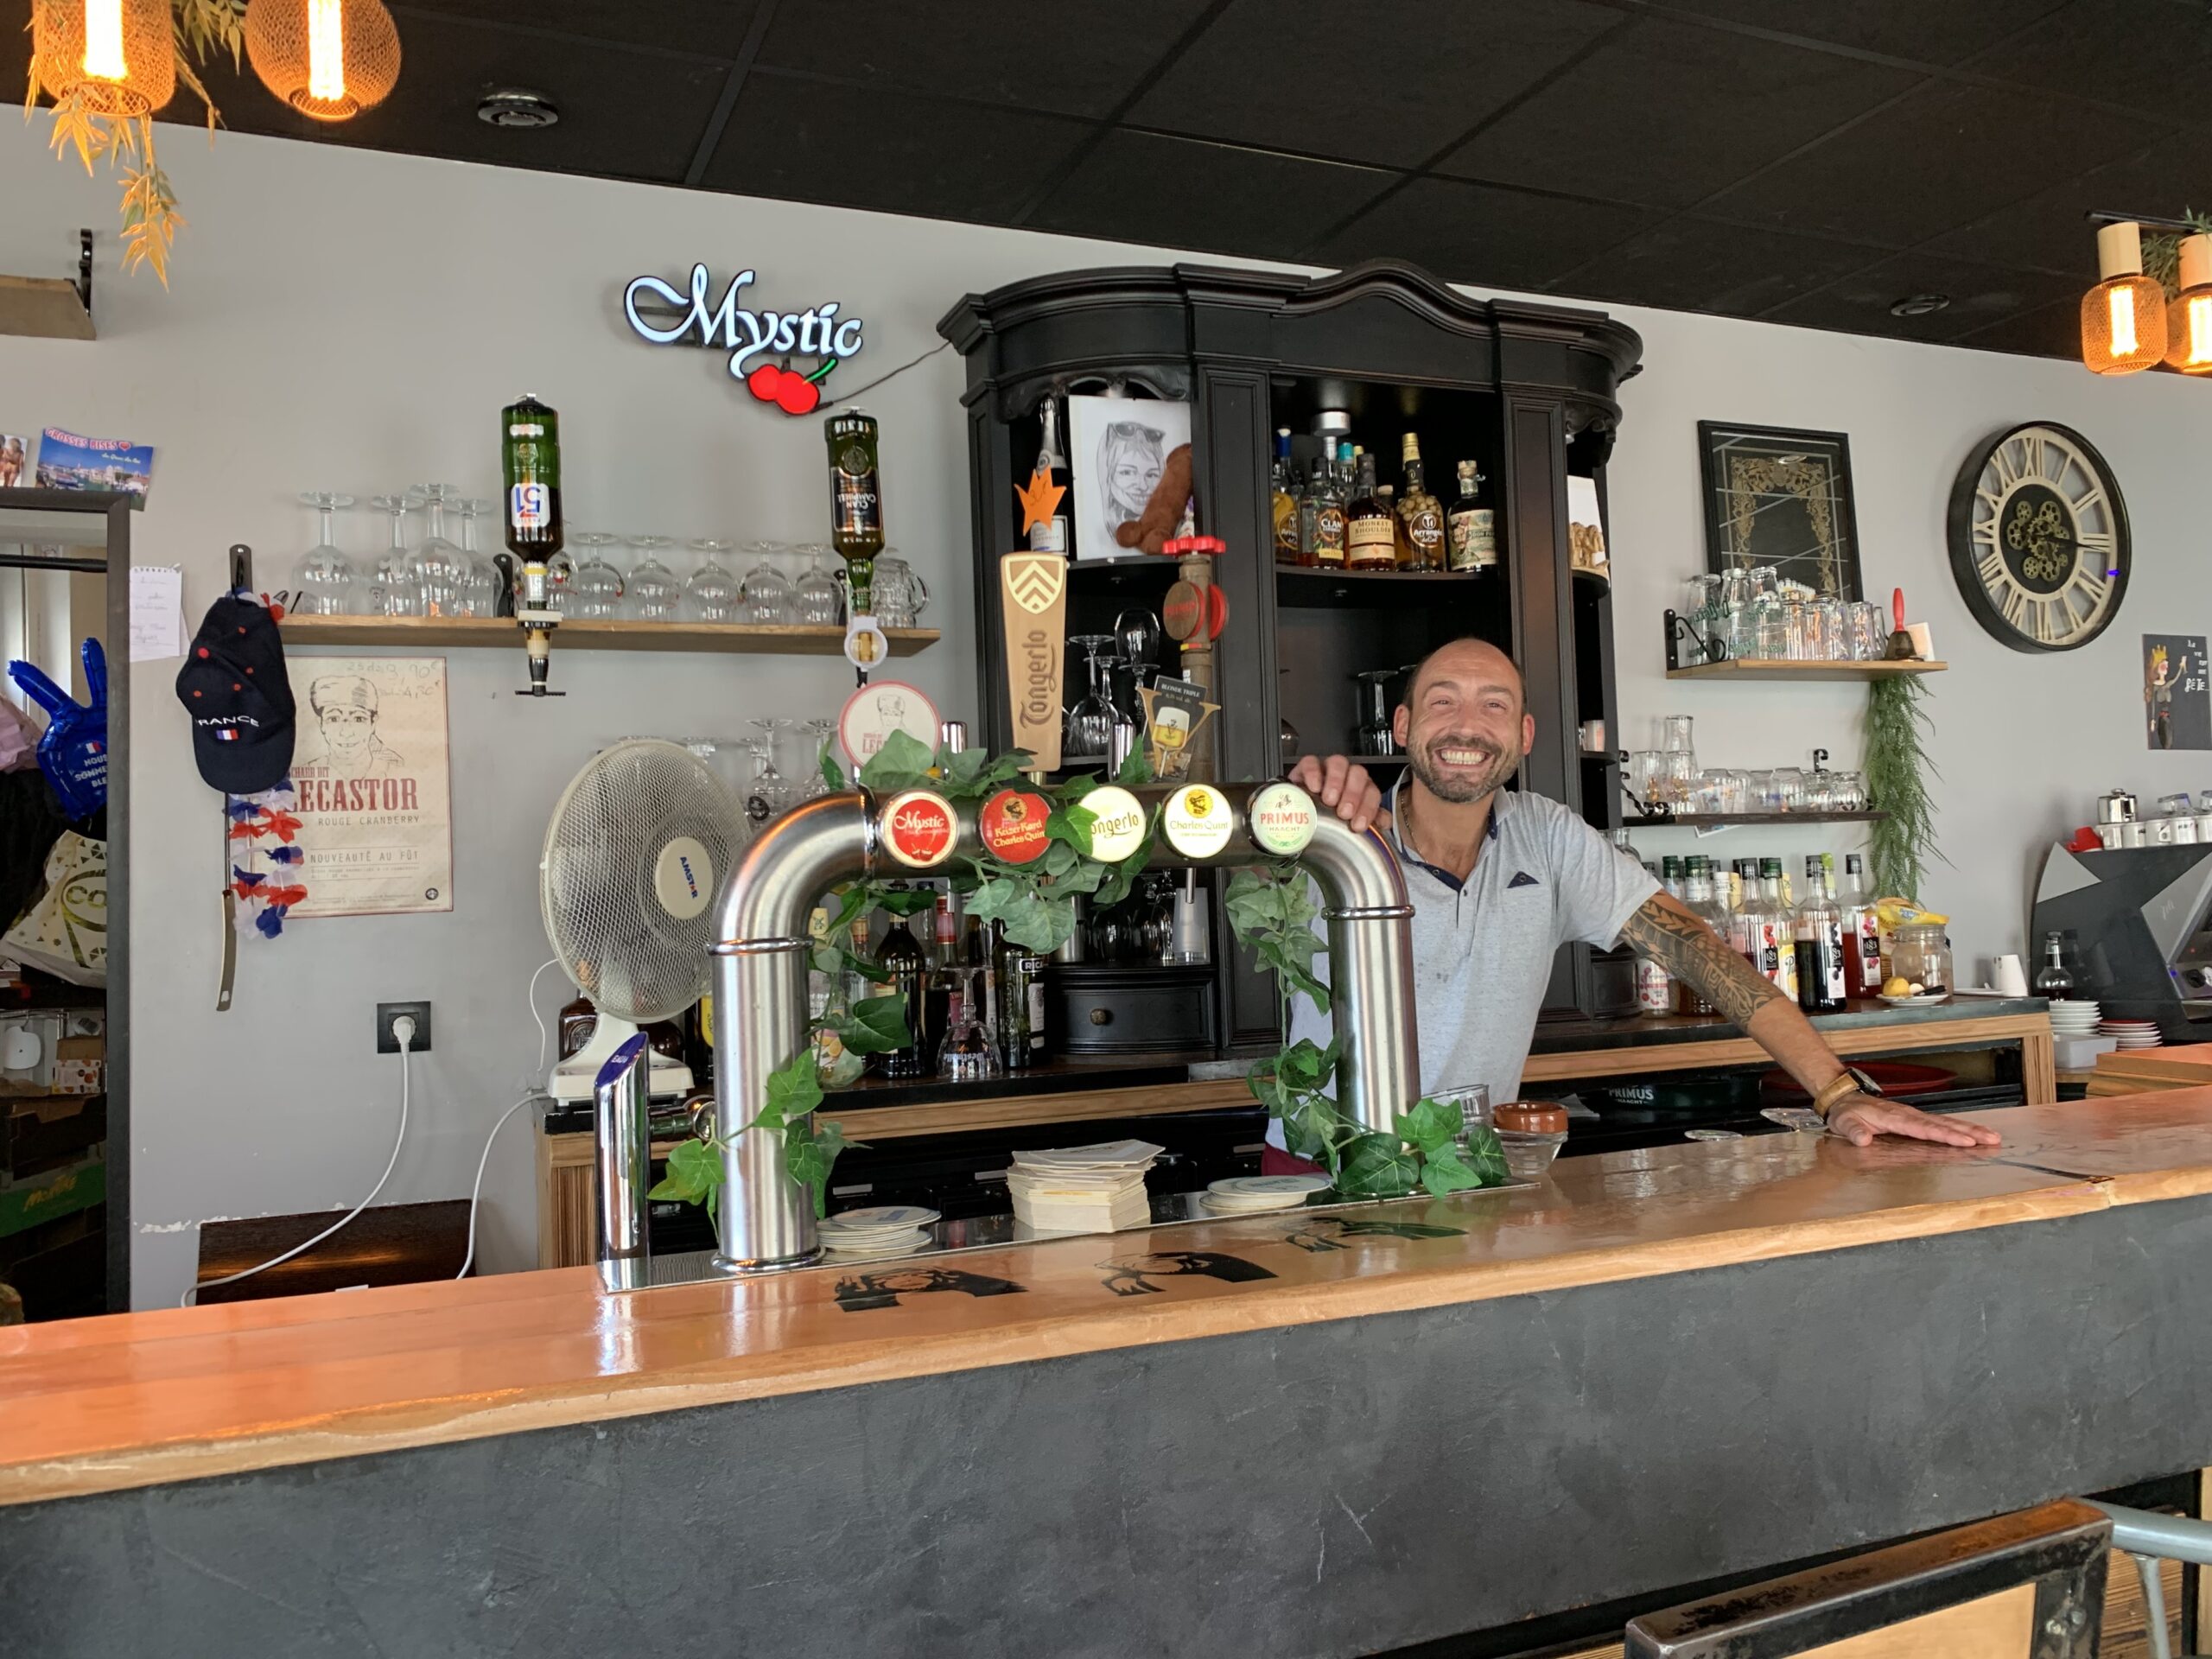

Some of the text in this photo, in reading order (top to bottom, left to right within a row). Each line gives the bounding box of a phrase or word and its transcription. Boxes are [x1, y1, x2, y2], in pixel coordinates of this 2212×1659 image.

[625, 264, 863, 380] Mystic
[46, 427, 118, 451] GROSSES BISES
[1320, 518, 1343, 528] CLAN
[1019, 629, 1057, 729] Tongerlo
[195, 715, 260, 727] RANCE
[74, 766, 107, 782] SOMME
[91, 777, 107, 788] BLE
[318, 816, 419, 826] ROUGE CRANBERRY
[893, 810, 945, 836] Mystic
[1091, 810, 1139, 839] ongerlo
[1260, 812, 1310, 825] PRIMUS
[995, 826, 1020, 838] Keizer
[1169, 820, 1229, 831] Charles Quint
[993, 830, 1046, 848] Charles Quin
[379, 853, 392, 861] AU
[1609, 1088, 1655, 1101] PRIMUS
